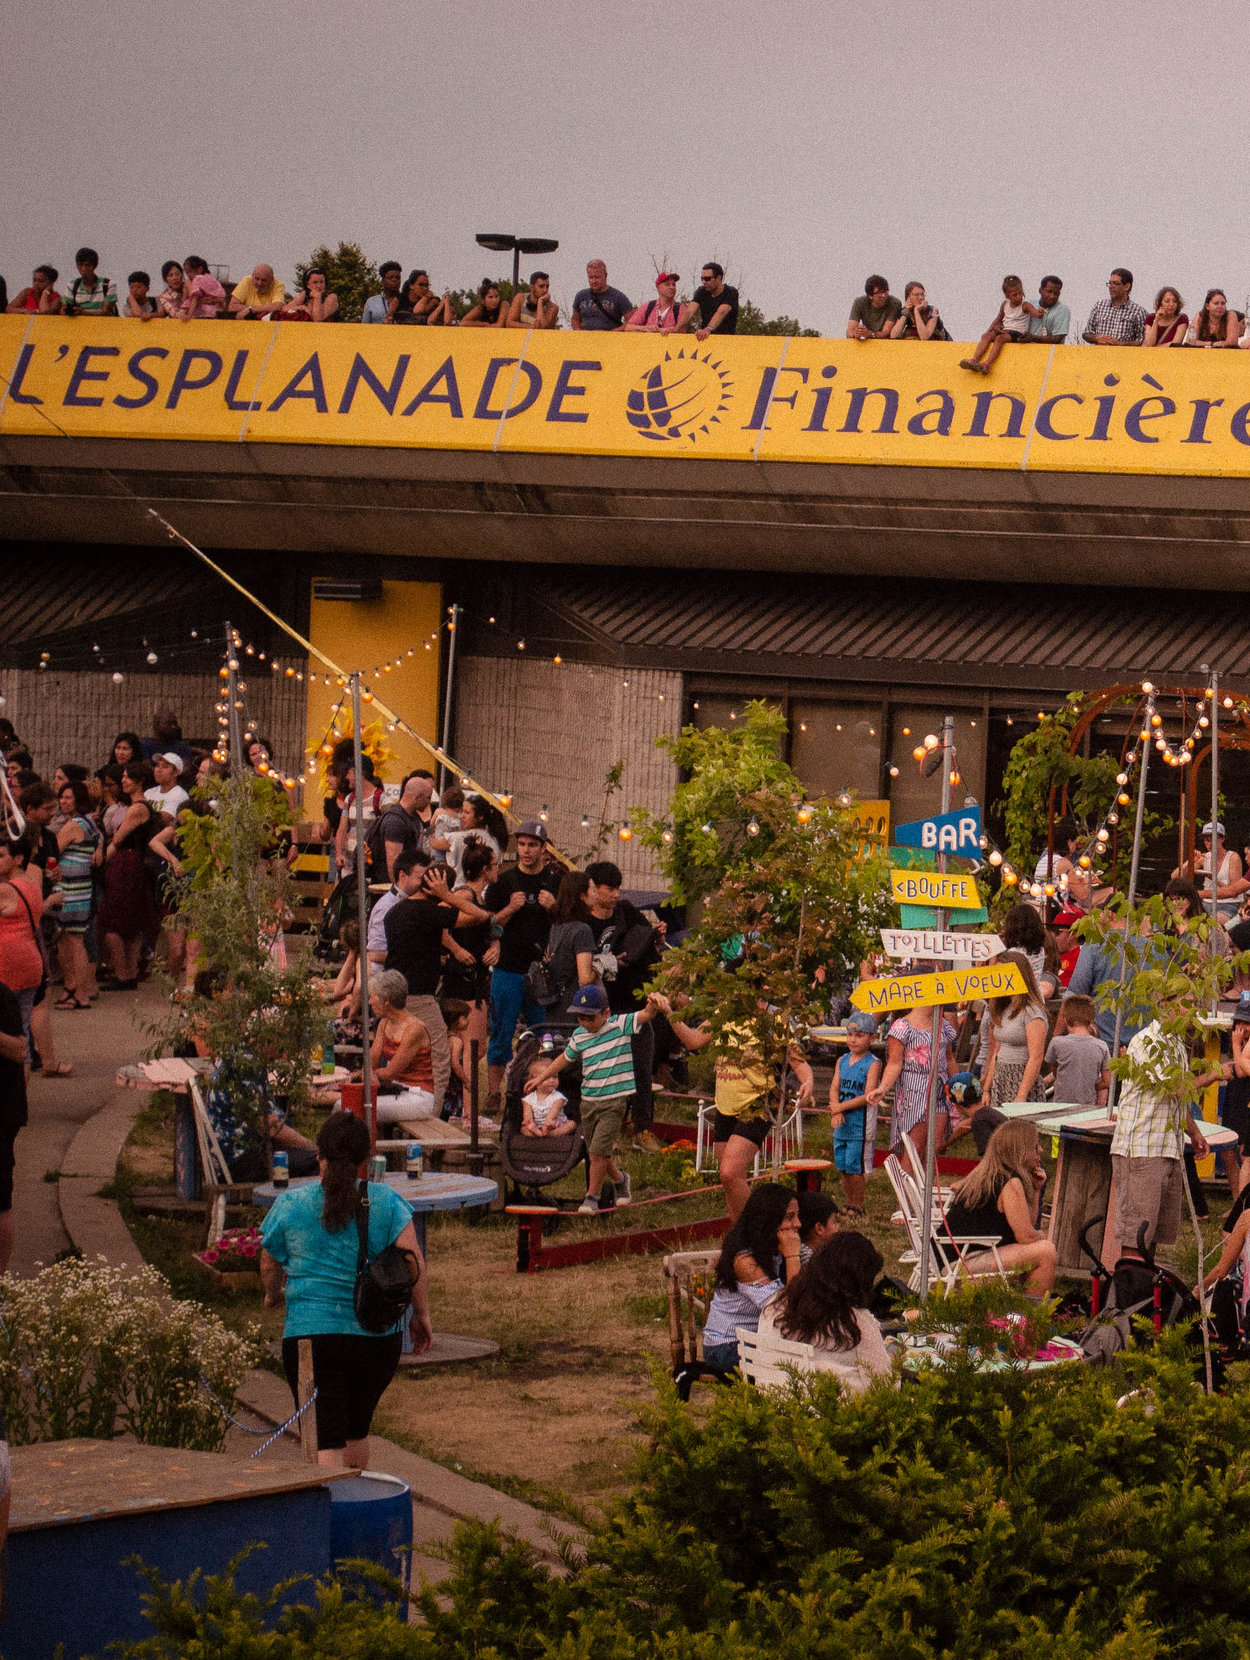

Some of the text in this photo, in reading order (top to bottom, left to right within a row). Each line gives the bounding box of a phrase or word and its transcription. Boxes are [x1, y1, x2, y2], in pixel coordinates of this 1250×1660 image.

[9, 343, 602, 422] L'ESPLANADE
[921, 818, 978, 851] BAR
[906, 877, 969, 899] BOUFFE
[890, 934, 992, 958] TOILLETTES
[868, 973, 1015, 1009] MARE À VOEUX
